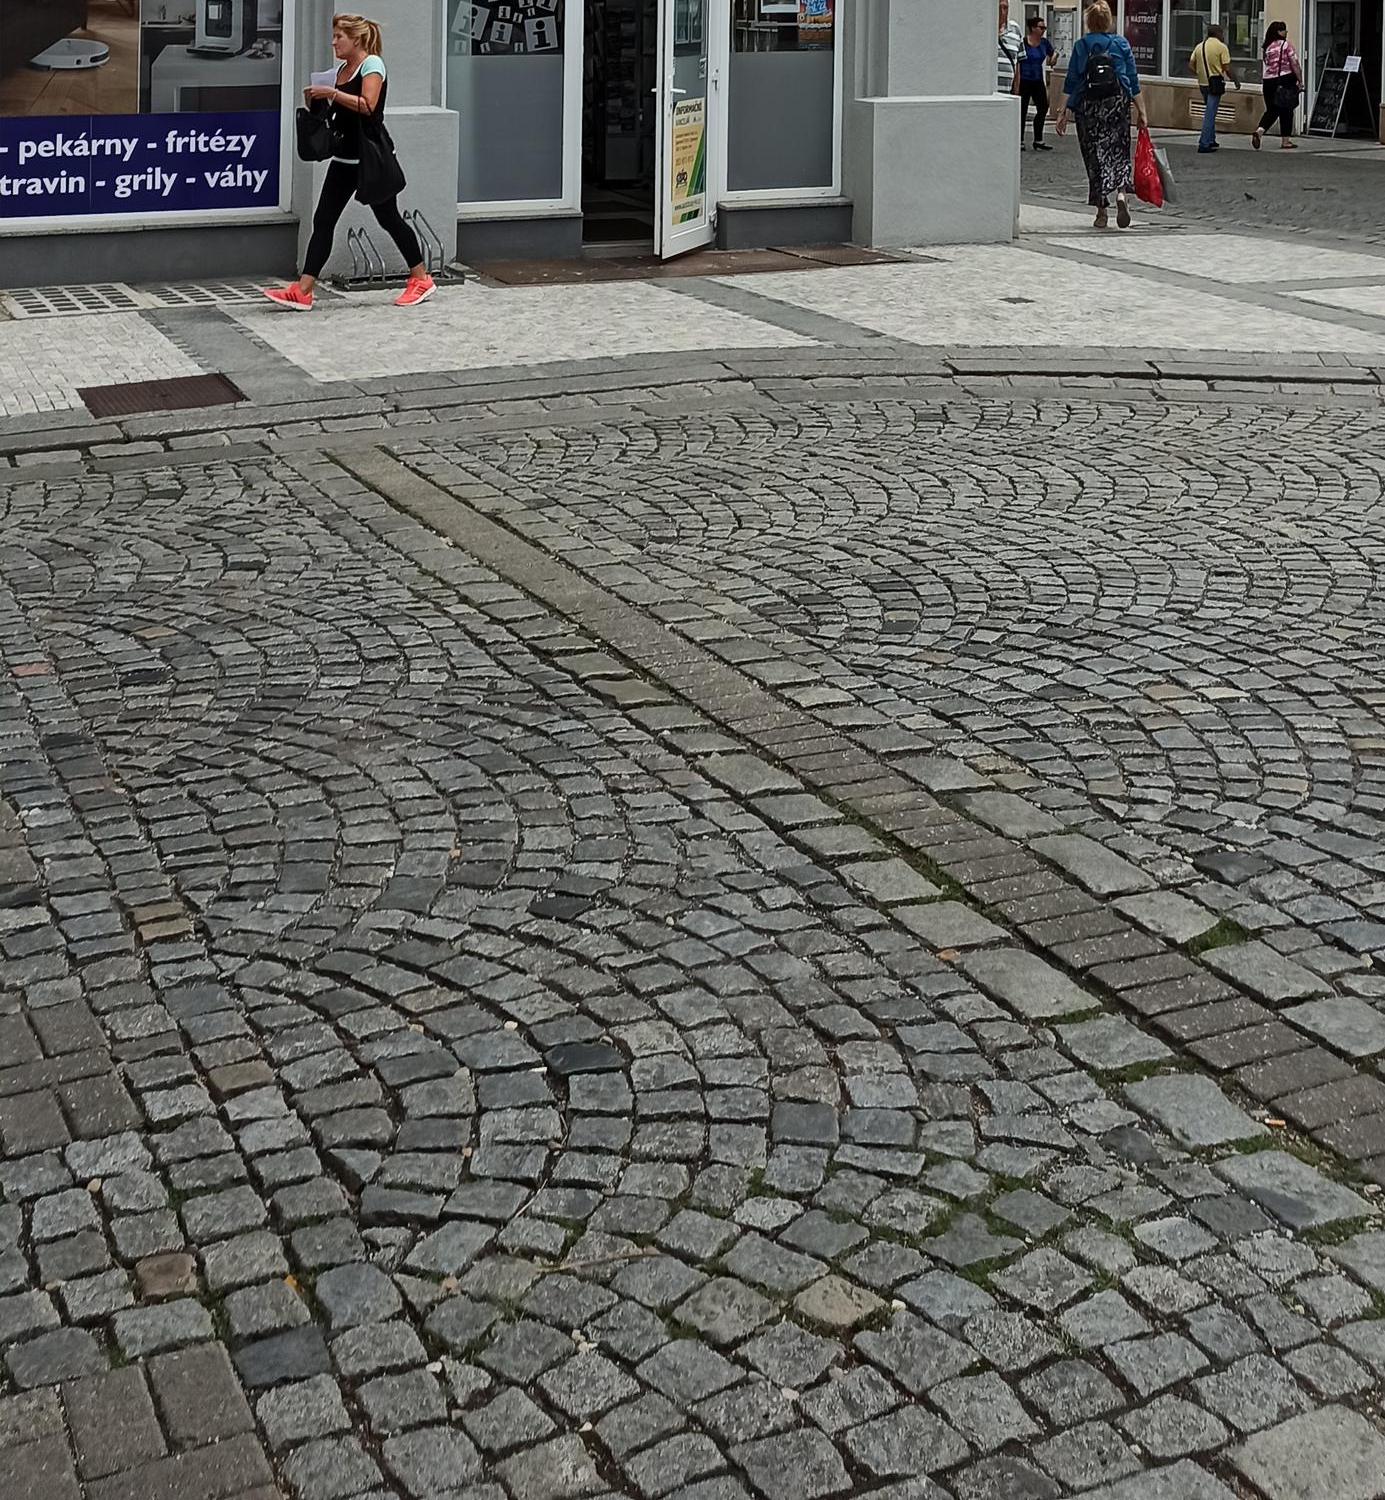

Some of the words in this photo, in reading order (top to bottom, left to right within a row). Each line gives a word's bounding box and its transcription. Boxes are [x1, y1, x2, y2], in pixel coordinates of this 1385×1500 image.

[18, 132, 139, 165] pekárny
[165, 128, 257, 157] fritézy
[114, 167, 178, 198] grily
[204, 164, 269, 191] váhy
